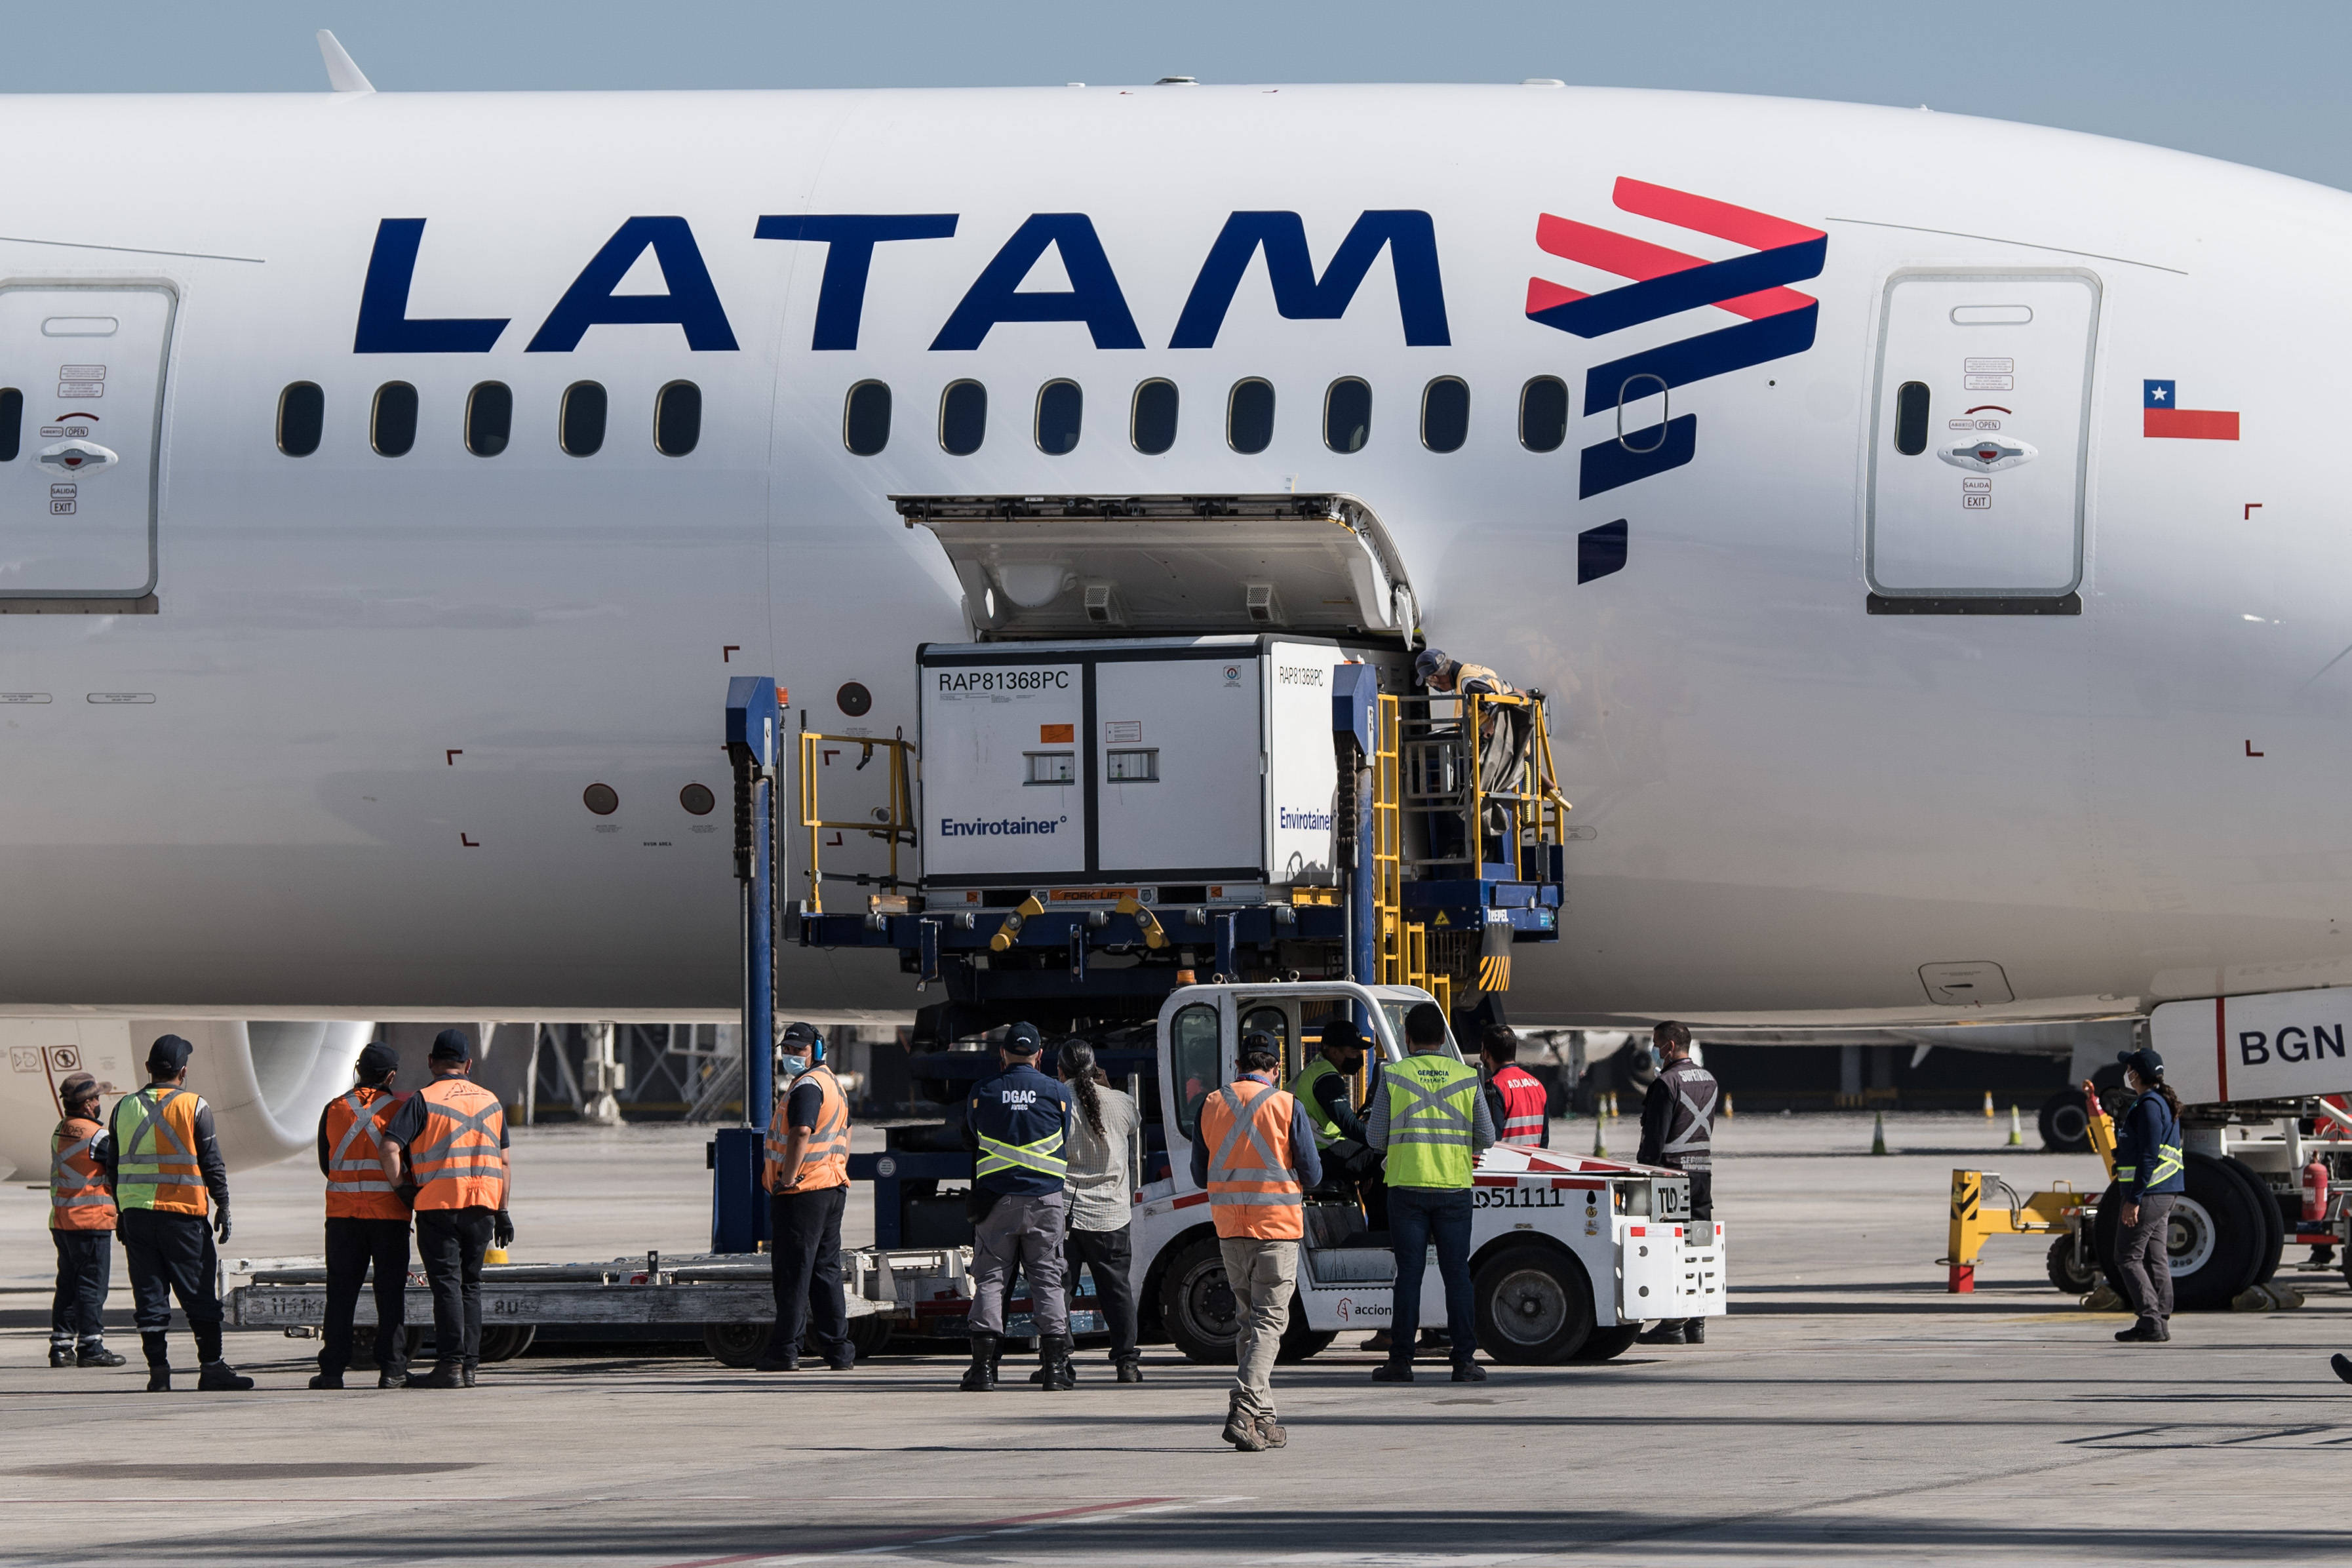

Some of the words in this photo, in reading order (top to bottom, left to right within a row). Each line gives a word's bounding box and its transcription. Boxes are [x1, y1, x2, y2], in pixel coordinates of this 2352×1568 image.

[353, 209, 1453, 353] LATAM
[54, 502, 72, 512] EXIT
[1967, 497, 1986, 507] EXIT
[939, 671, 1068, 691] RAP81368PC
[1280, 666, 1323, 687] RAP81368PC
[1063, 892, 1095, 900] FORK
[1100, 891, 1124, 899] LIFT
[2239, 1024, 2346, 1065] BGN
[1002, 1089, 1036, 1103] DGAC
[1658, 1187, 1677, 1213] TLD
